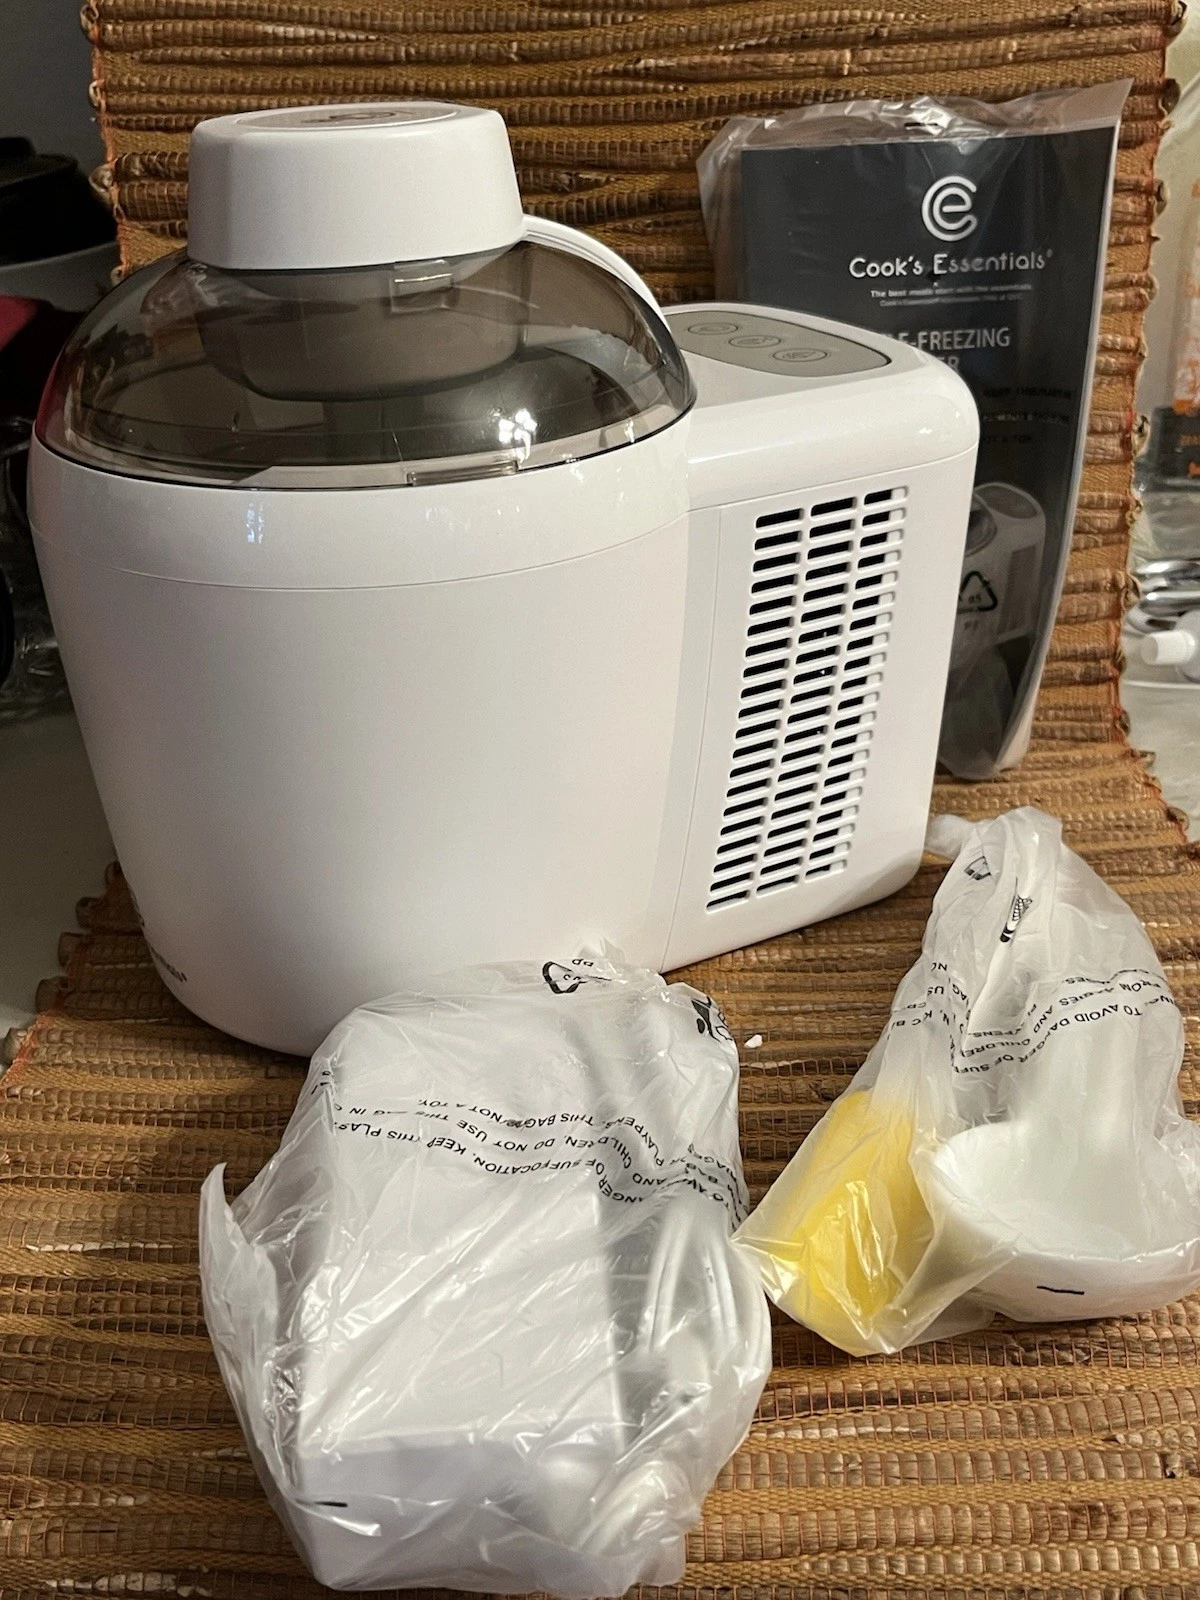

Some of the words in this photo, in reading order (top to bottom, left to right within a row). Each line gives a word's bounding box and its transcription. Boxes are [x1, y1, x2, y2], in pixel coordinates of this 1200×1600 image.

[849, 255, 924, 279] Cook's
[1074, 1004, 1119, 1022] AVOID
[1123, 1005, 1142, 1016] TO
[1033, 1005, 1053, 1034] AND
[349, 1107, 368, 1116] IN
[468, 1105, 503, 1123] NOT
[560, 1112, 594, 1126] THIS
[456, 1119, 489, 1142] USE
[427, 1137, 467, 1155] KEEP
[492, 1140, 529, 1152] NOT
[533, 1138, 556, 1151] DO
[585, 1159, 605, 1175] OF
